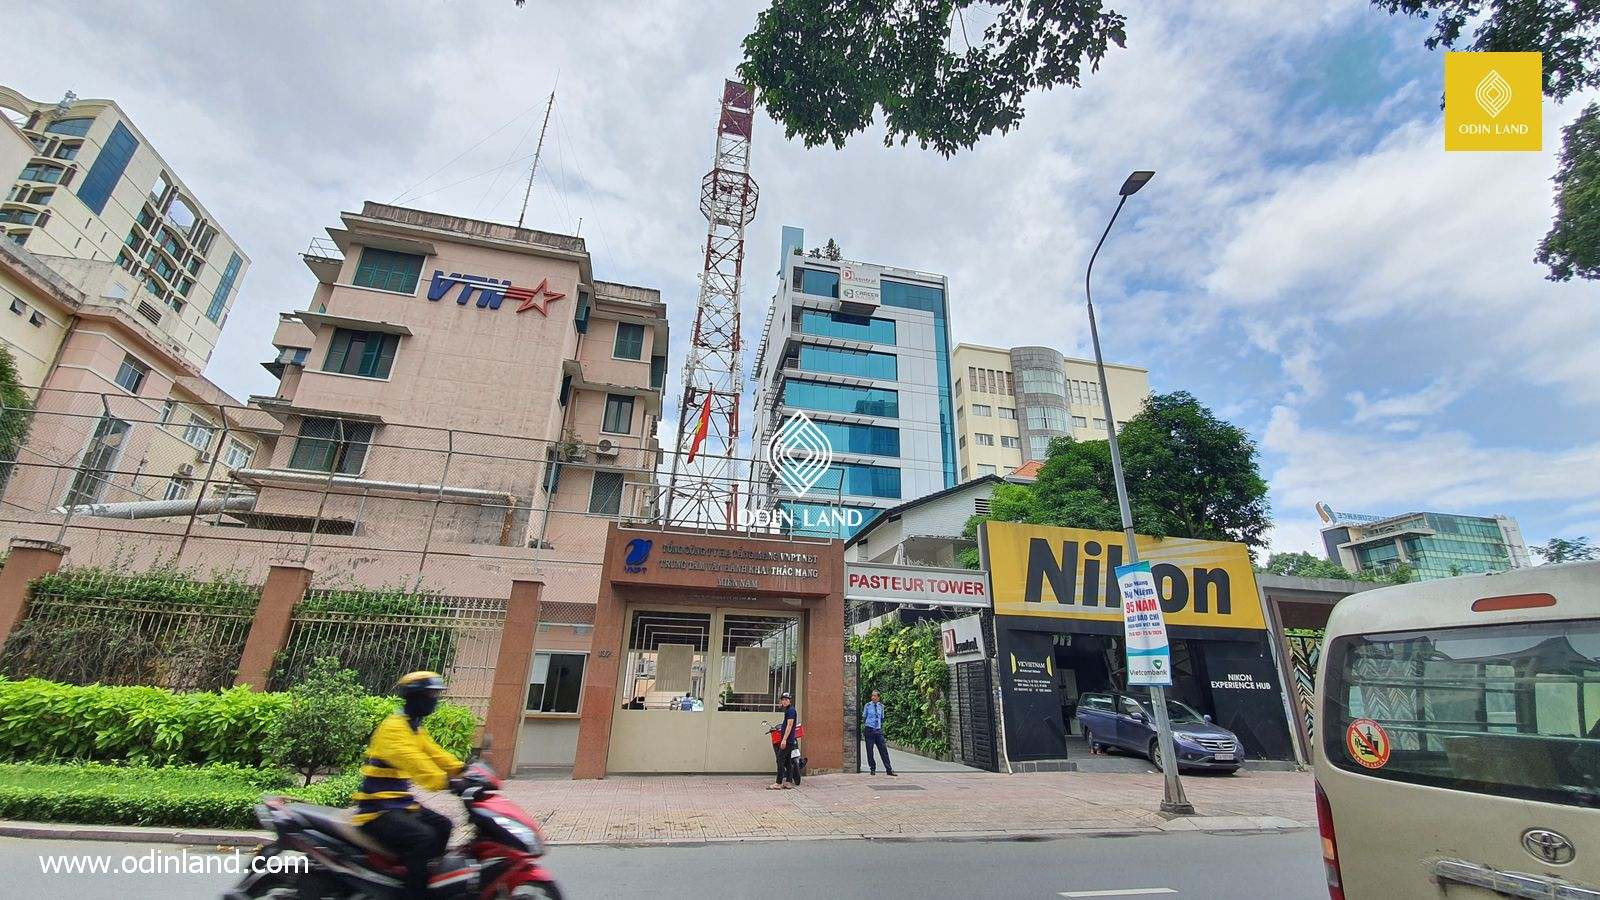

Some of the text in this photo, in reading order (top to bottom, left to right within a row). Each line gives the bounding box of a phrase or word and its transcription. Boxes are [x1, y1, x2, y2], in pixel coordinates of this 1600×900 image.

[427, 270, 512, 310] VTN
[660, 559, 687, 569] TRUNG
[771, 564, 793, 576] THÁC
[795, 567, 818, 580] MẠNG
[740, 578, 758, 588] NAM
[849, 574, 984, 596] PASTEUR TOWER
[1126, 598, 1157, 613] 95 NĂM
[844, 654, 857, 662] 139
[1227, 673, 1252, 682] NIKON
[1211, 681, 1271, 690] EXPERIENCE HUB
